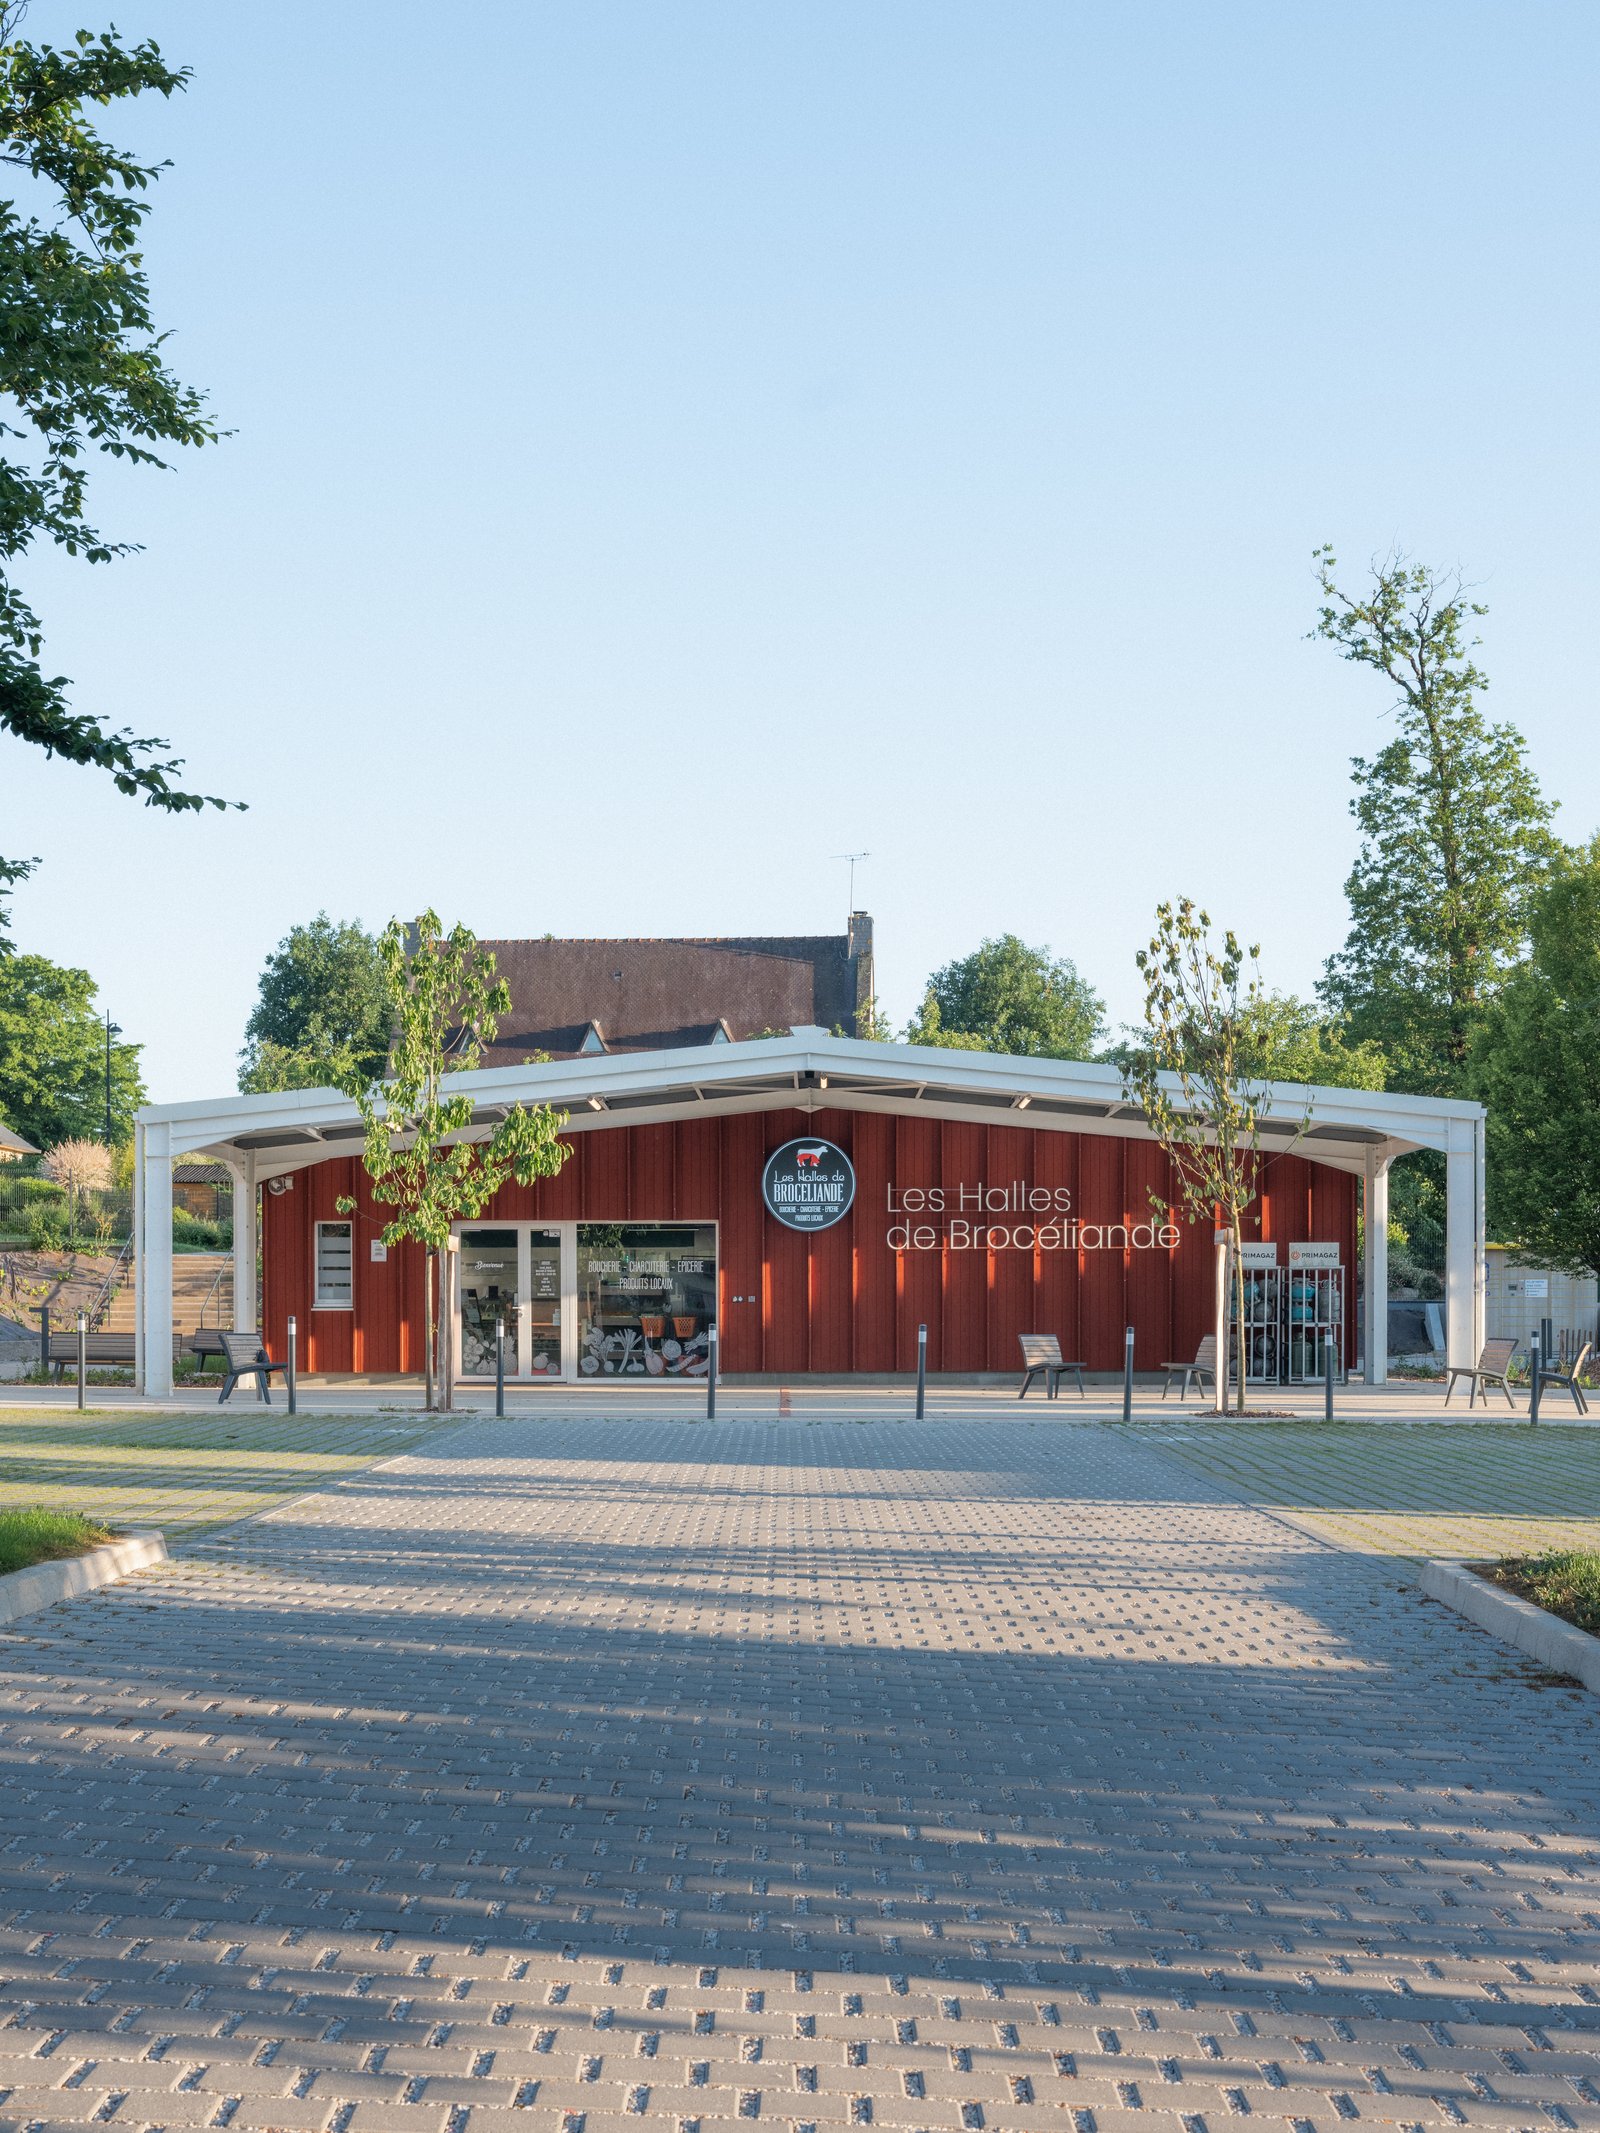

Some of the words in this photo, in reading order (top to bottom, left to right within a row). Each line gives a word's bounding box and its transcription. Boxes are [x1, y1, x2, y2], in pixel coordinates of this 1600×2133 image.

[774, 1170, 794, 1183] Les
[798, 1169, 828, 1182] Halles
[832, 1169, 845, 1181] de
[773, 1183, 843, 1202] BROCELIANDE
[887, 1182, 945, 1212] Les
[960, 1180, 1071, 1212] Halles
[886, 1219, 936, 1250] de
[950, 1216, 1181, 1250] Brocéliande
[588, 1260, 621, 1273] BOUCHERIE
[629, 1260, 670, 1273] CHARCUTERIE
[677, 1260, 704, 1273] EPICERIE
[619, 1277, 649, 1290] PRODUITS
[650, 1277, 673, 1290] LOCAUX
